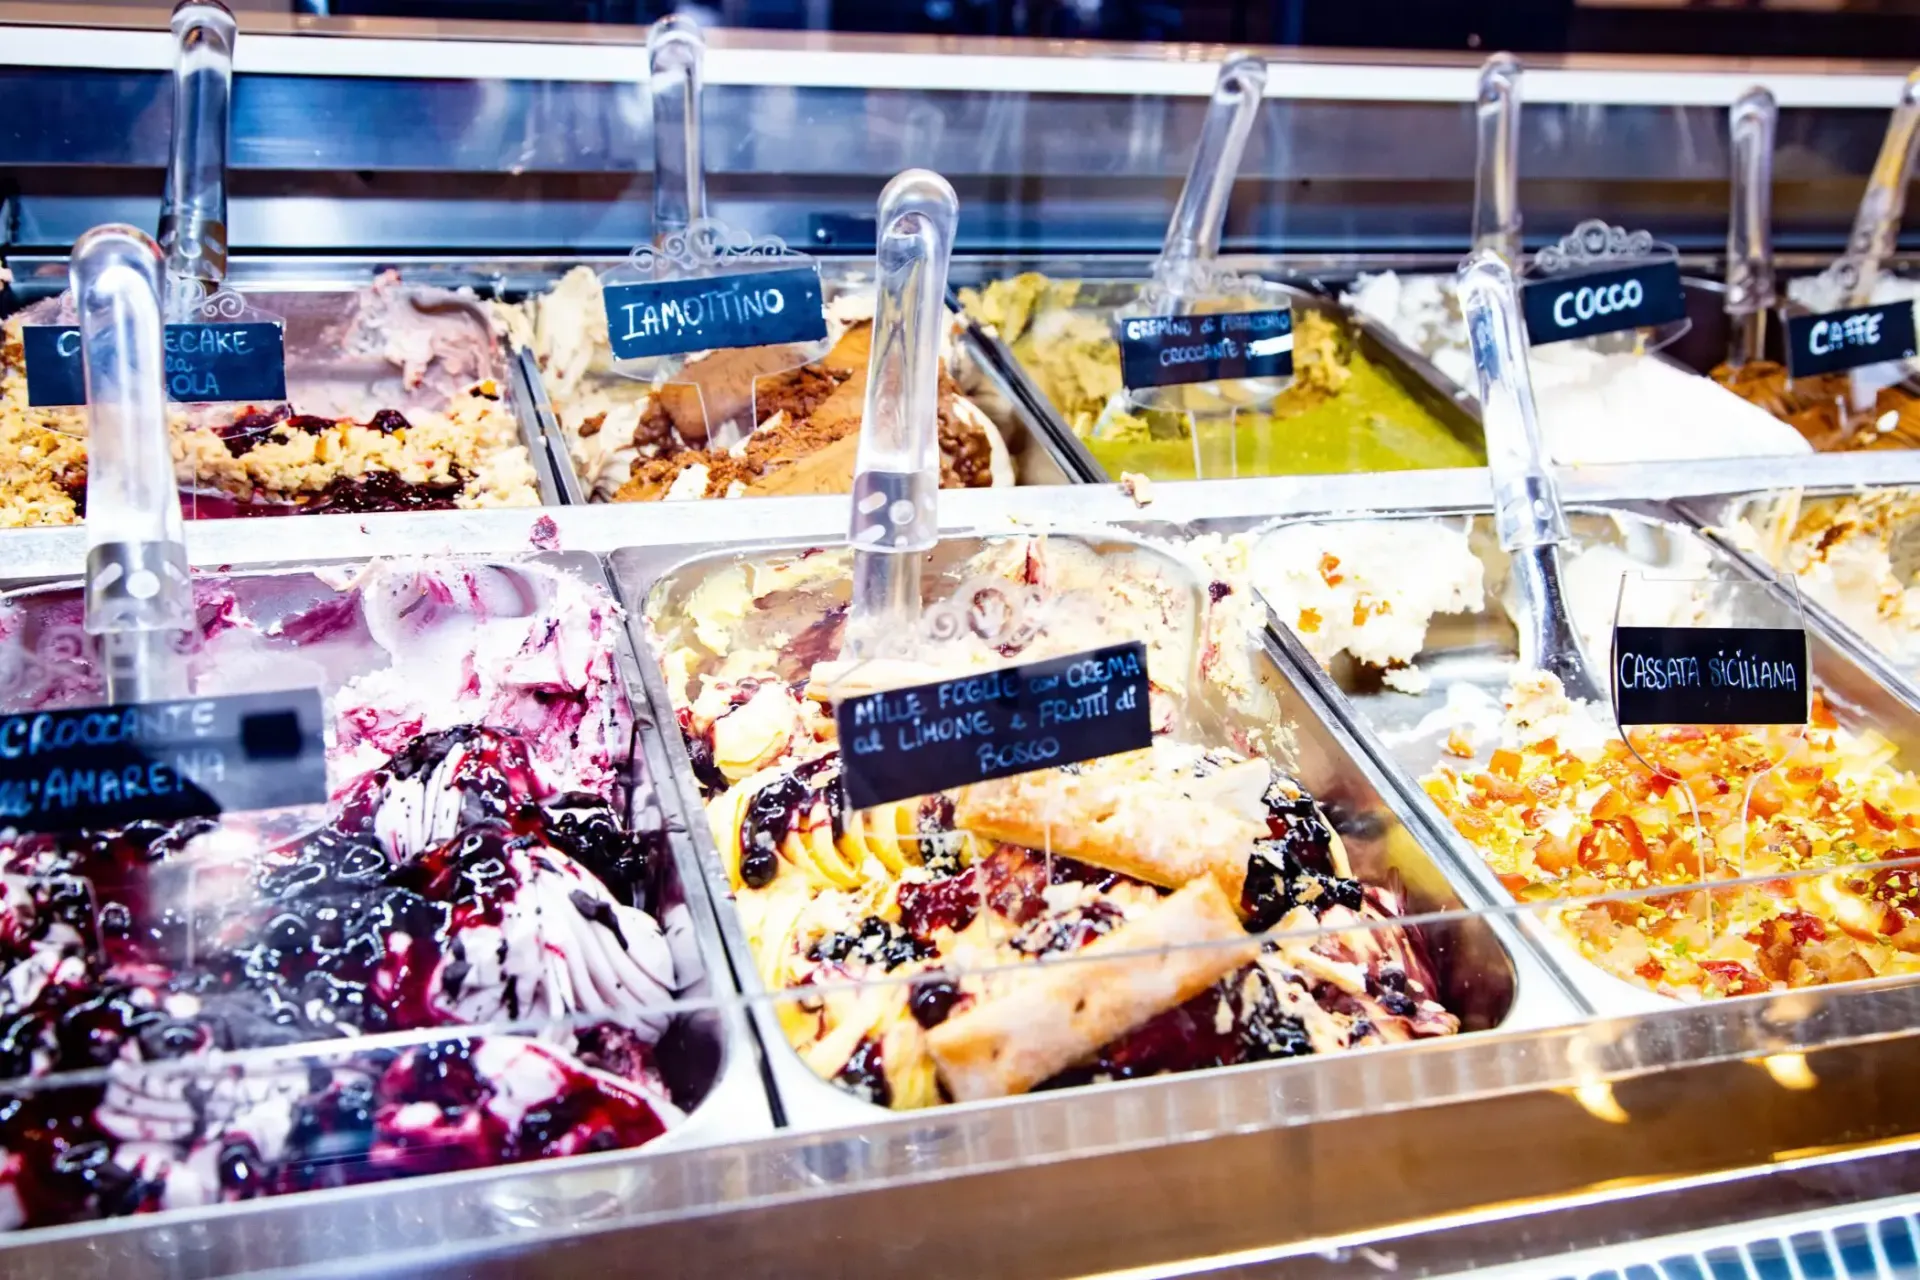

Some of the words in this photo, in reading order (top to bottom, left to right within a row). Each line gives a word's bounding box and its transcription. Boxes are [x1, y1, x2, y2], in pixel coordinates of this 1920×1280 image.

[1553, 279, 1643, 328] COCCO
[1127, 316, 1192, 340] CREMINO
[854, 692, 925, 726] MILLE
[1066, 652, 1141, 688] CREMA
[1620, 652, 1700, 690] CASSATA
[853, 732, 885, 755] al
[1115, 684, 1137, 712] di
[977, 737, 1060, 774] BOSCO
